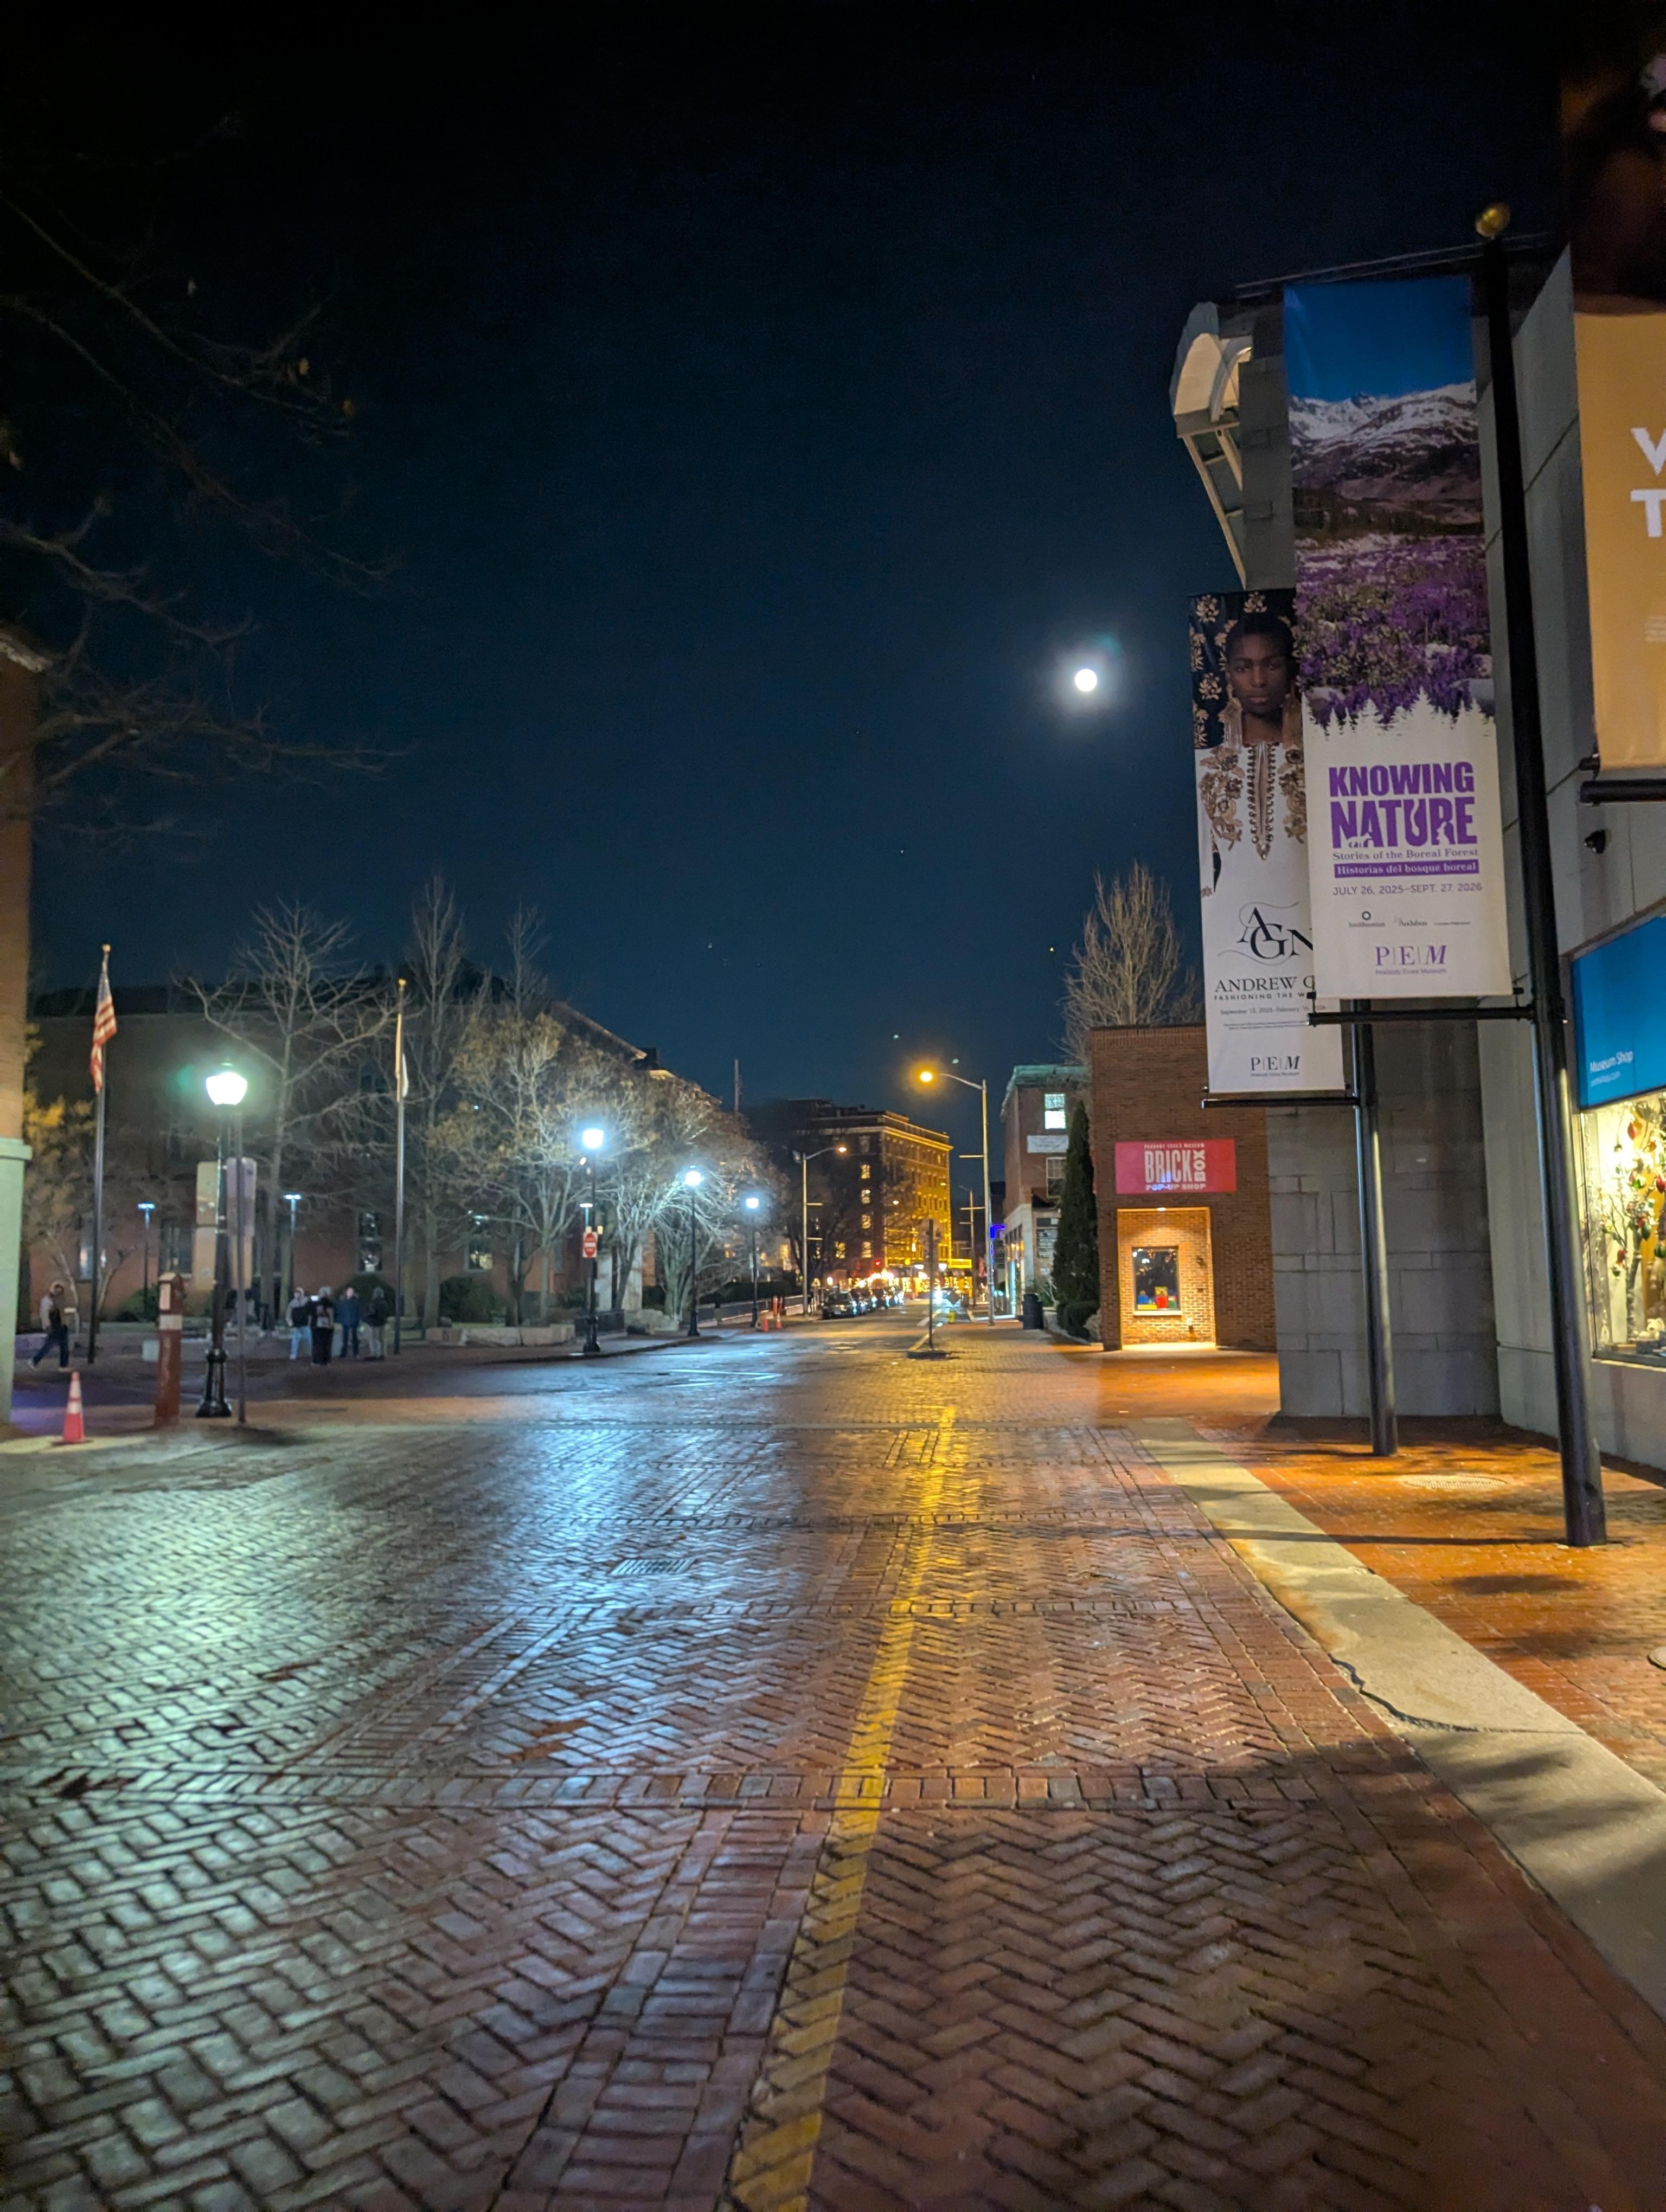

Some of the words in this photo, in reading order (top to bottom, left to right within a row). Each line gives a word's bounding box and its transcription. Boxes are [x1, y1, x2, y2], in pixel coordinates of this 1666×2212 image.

[1329, 761, 1475, 797] KNOWING
[1330, 796, 1477, 848] NATURE
[1333, 851, 1370, 860] Stories
[1373, 851, 1383, 860] of
[1386, 851, 1403, 859] the
[1406, 850, 1441, 858] Boreal
[1445, 848, 1478, 857] Forest
[1337, 866, 1383, 874] Historias
[1386, 864, 1402, 873] del
[1405, 864, 1440, 873] bosque
[1444, 862, 1476, 871] boreal
[1333, 886, 1357, 896] JULY
[1457, 883, 1482, 892] 2026
[1215, 976, 1297, 992] ANDREW
[1144, 1149, 1193, 1183] BRICK
[1193, 1149, 1206, 1182] BOX
